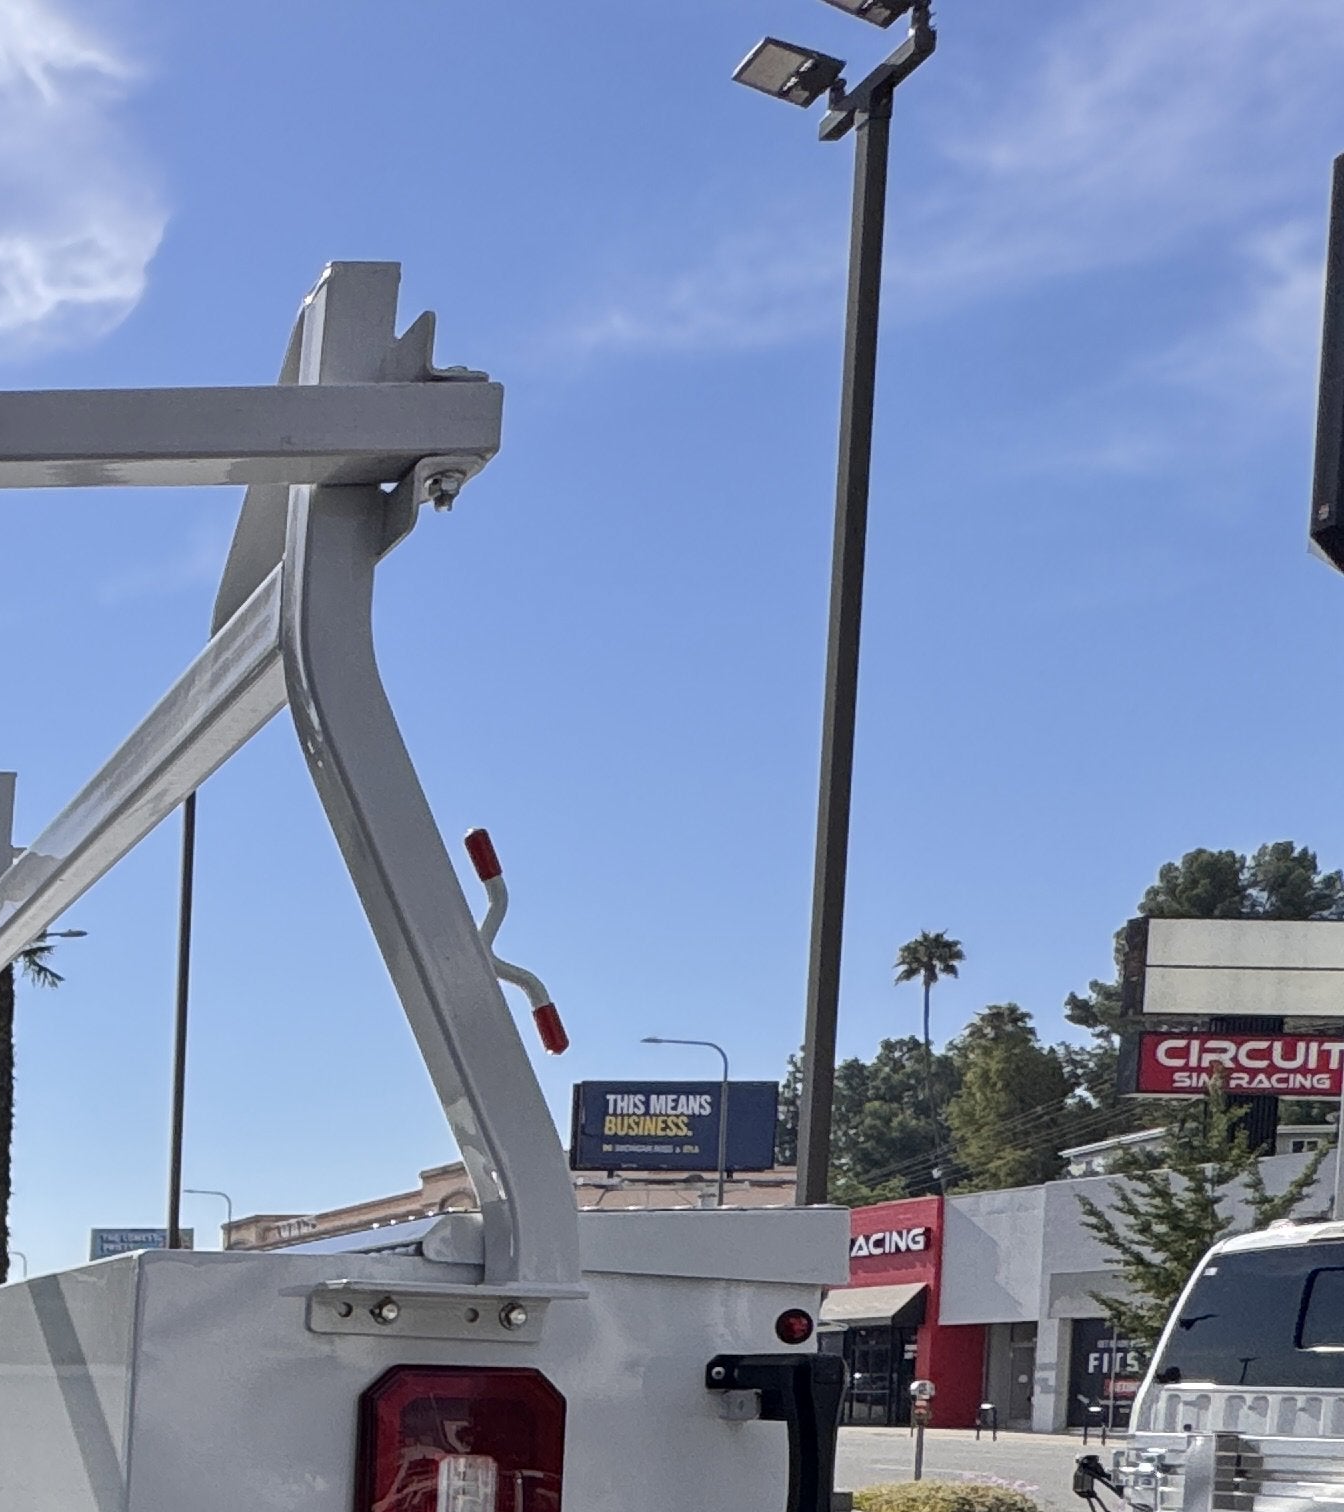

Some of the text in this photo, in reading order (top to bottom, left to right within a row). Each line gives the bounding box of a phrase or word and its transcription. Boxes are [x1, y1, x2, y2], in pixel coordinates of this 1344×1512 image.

[1156, 1039, 1344, 1069] CIRCUIT
[1229, 1072, 1330, 1089] RACING
[606, 1094, 712, 1116] THIS MEANS
[604, 1115, 693, 1137] BUSINESS.
